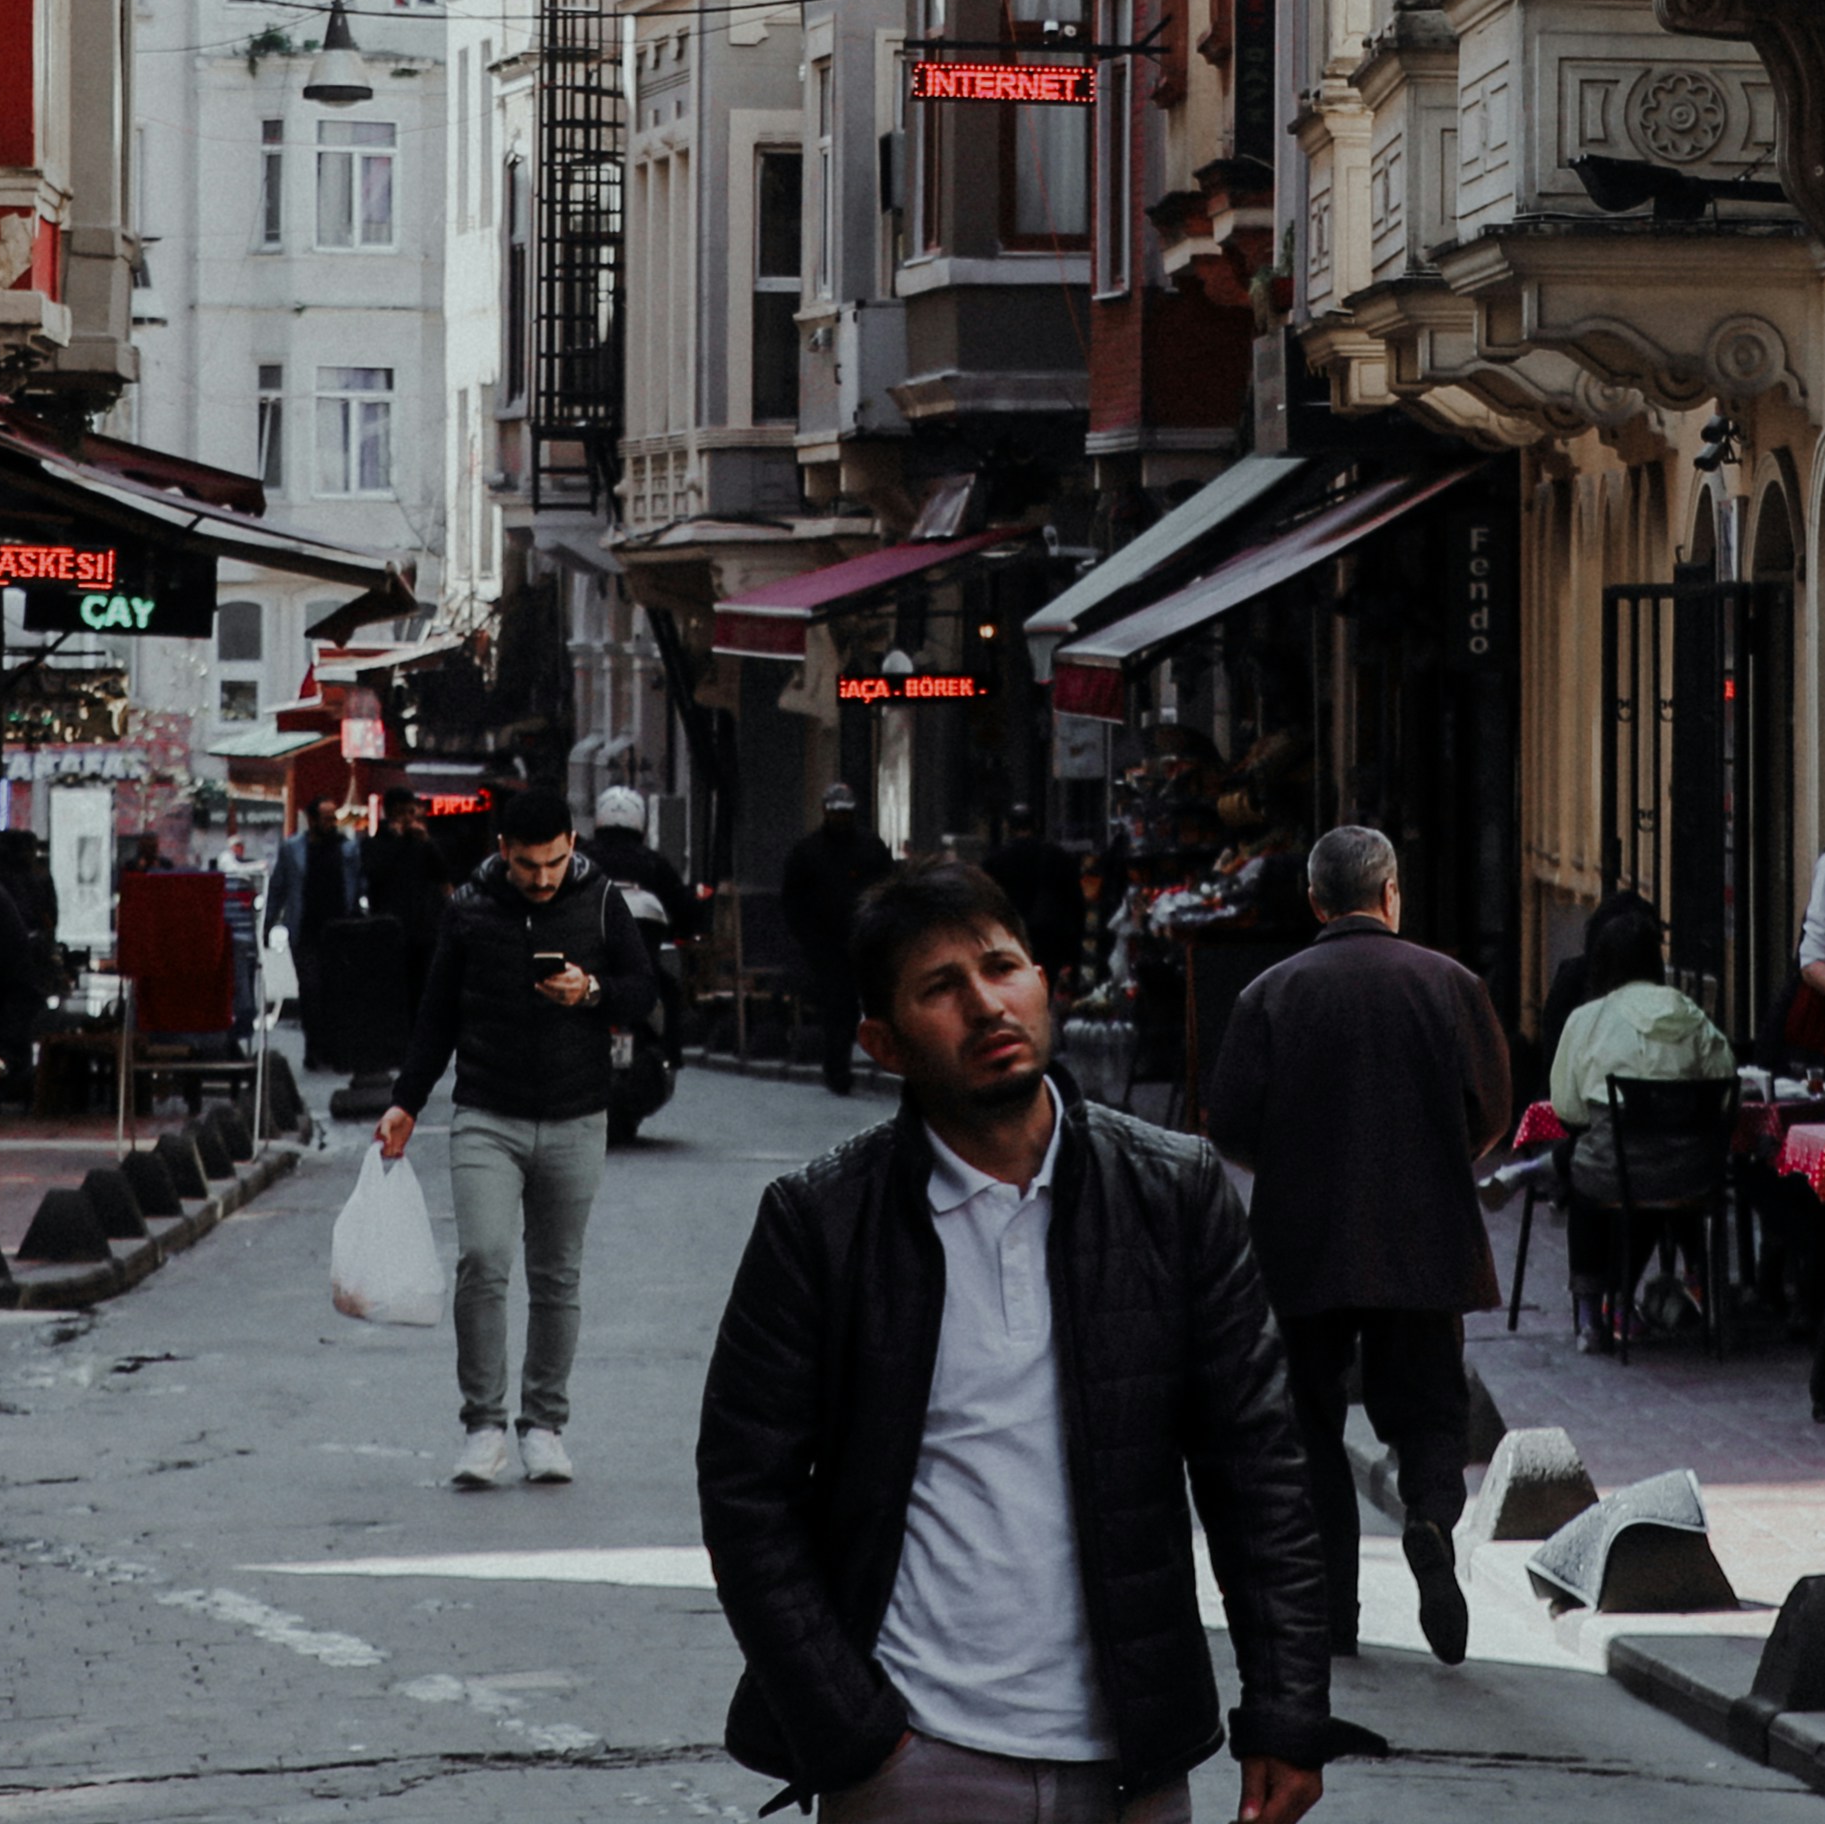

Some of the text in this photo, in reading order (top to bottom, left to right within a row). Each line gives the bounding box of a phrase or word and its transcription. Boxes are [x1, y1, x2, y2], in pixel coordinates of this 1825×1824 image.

[1469, 526, 1491, 656] Fendo
[80, 594, 155, 630] ÇAY
[905, 676, 974, 698] BÖREK
